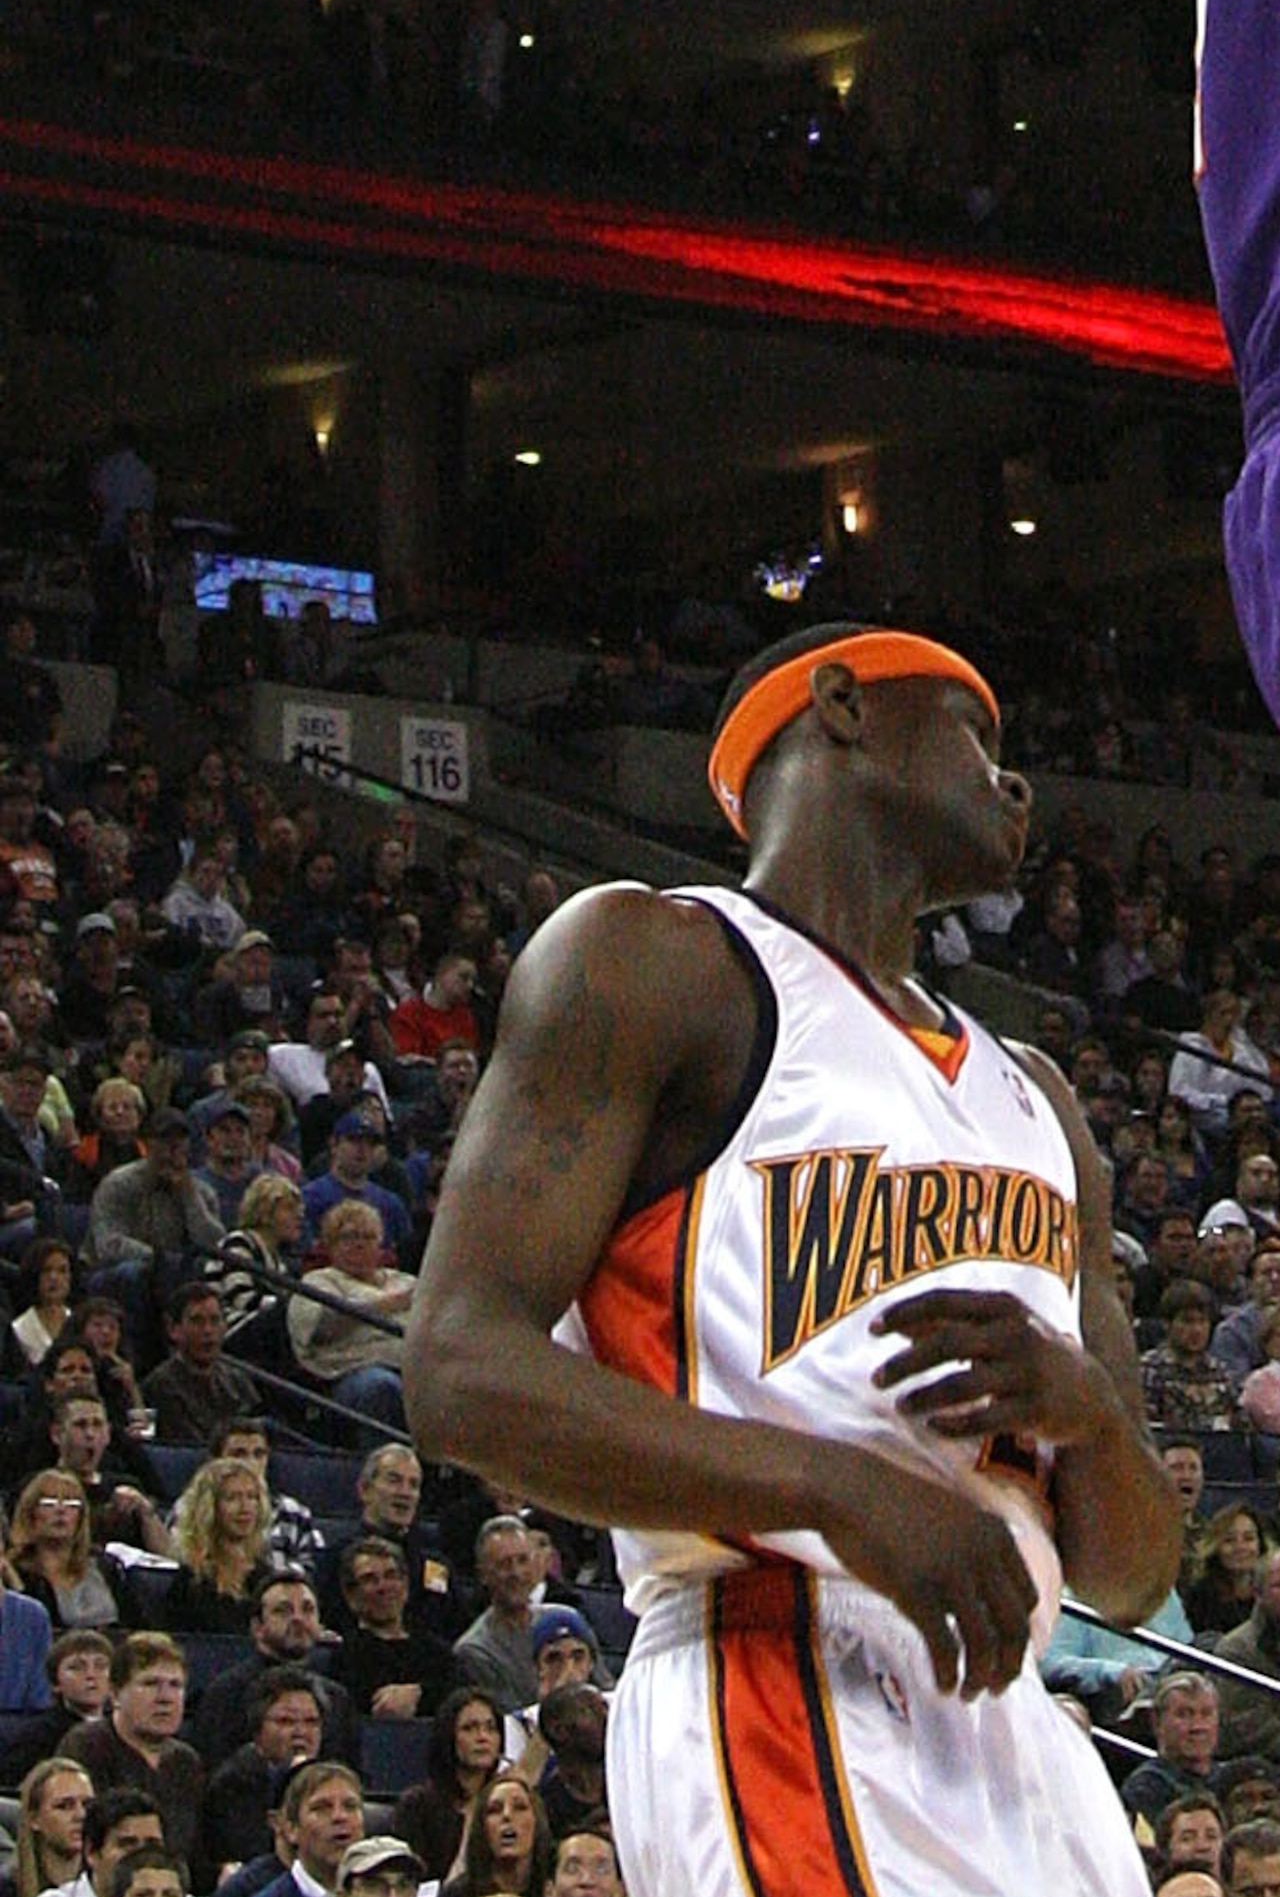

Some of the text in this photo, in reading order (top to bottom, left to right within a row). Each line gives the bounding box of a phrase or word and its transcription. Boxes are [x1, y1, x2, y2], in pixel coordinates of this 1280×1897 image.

[298, 716, 337, 739] SEC
[415, 727, 454, 751] SEC
[409, 753, 462, 792] 116
